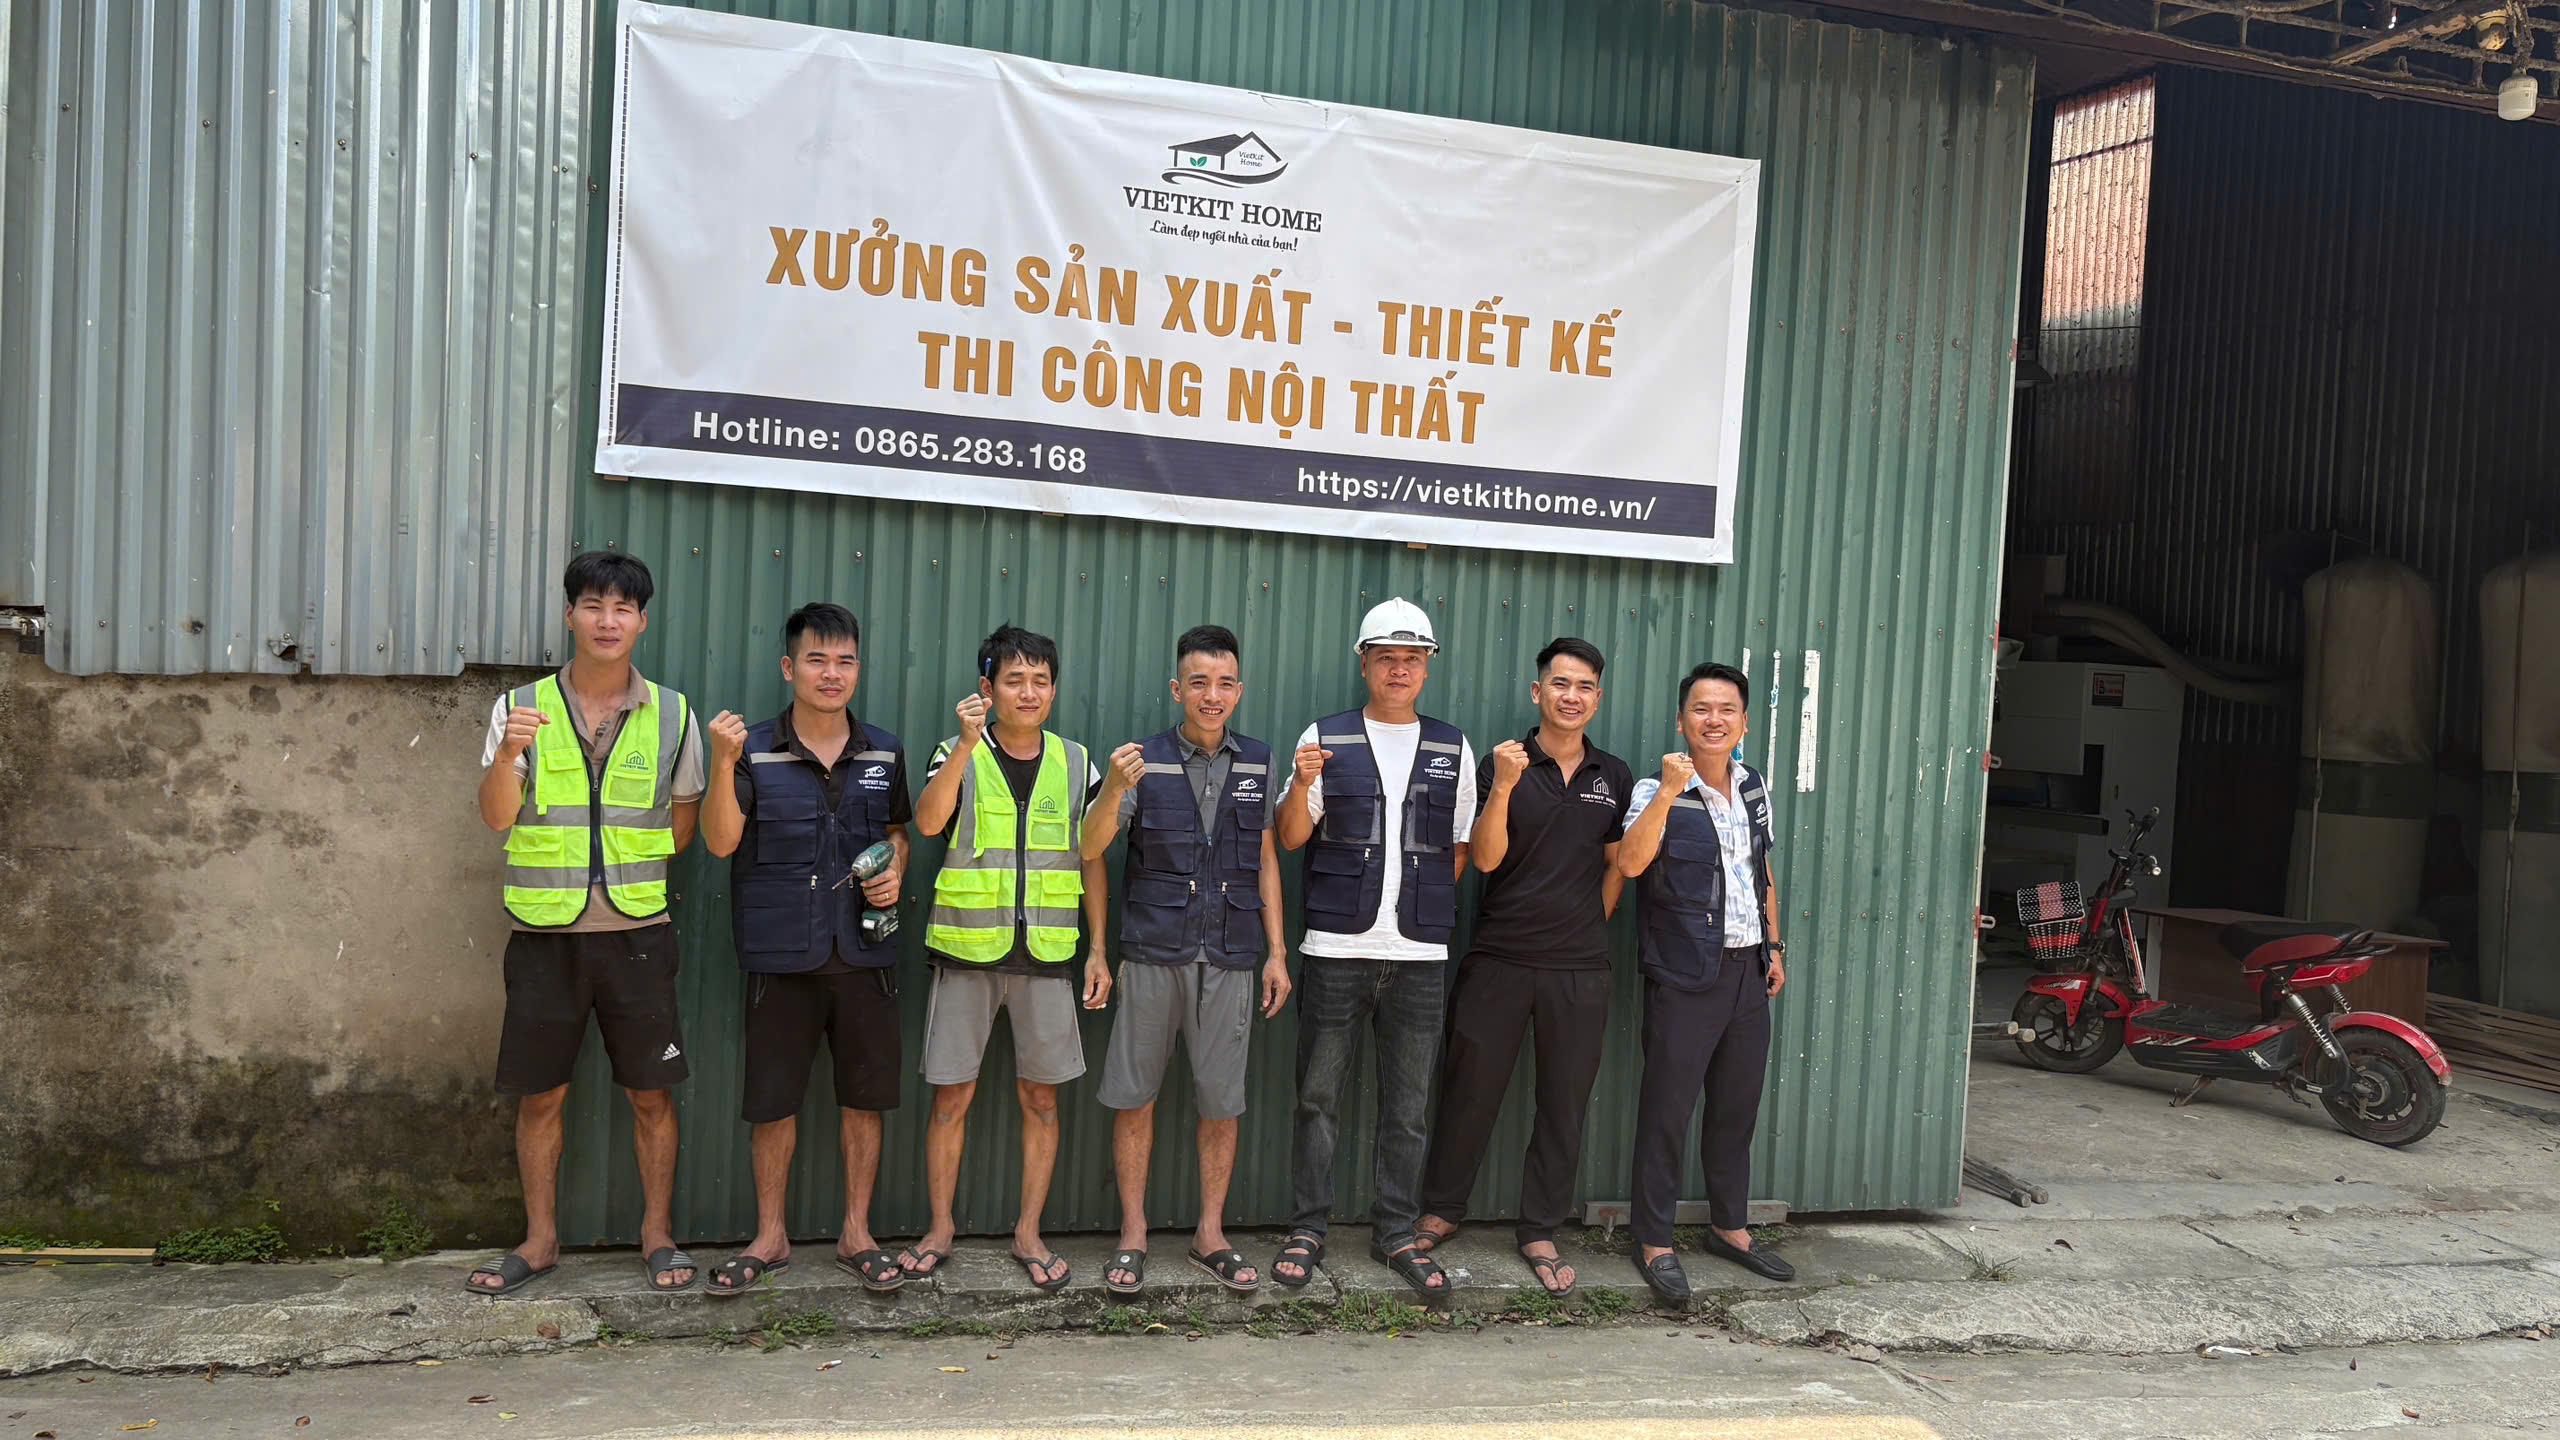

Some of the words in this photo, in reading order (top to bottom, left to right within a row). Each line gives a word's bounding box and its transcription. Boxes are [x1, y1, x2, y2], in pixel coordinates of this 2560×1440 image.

[1122, 186, 1234, 221] VIETKIT
[1240, 202, 1322, 233] HOME
[1150, 219, 1179, 236] Làm
[1180, 223, 1200, 242] đẹp
[1202, 228, 1227, 246] ngôi
[1227, 231, 1249, 246] nhà
[1250, 233, 1271, 249] của
[1272, 236, 1298, 253] bạn!
[766, 217, 987, 308] XƯỞNG
[1014, 243, 1138, 326] SẢN
[1162, 268, 1312, 345] XUẤT
[1333, 320, 1353, 334] -
[1378, 295, 1530, 369] THIẾT
[1549, 308, 1623, 378] KẾ
[918, 330, 1015, 397] THI
[1041, 339, 1204, 418] CÔNG
[1226, 361, 1326, 440] NỘI
[1349, 370, 1486, 445] THẤT
[692, 411, 840, 451] Hotline:
[854, 426, 1088, 475] 0865.283.168
[1297, 467, 1657, 521] https://vietkithome.vn/
